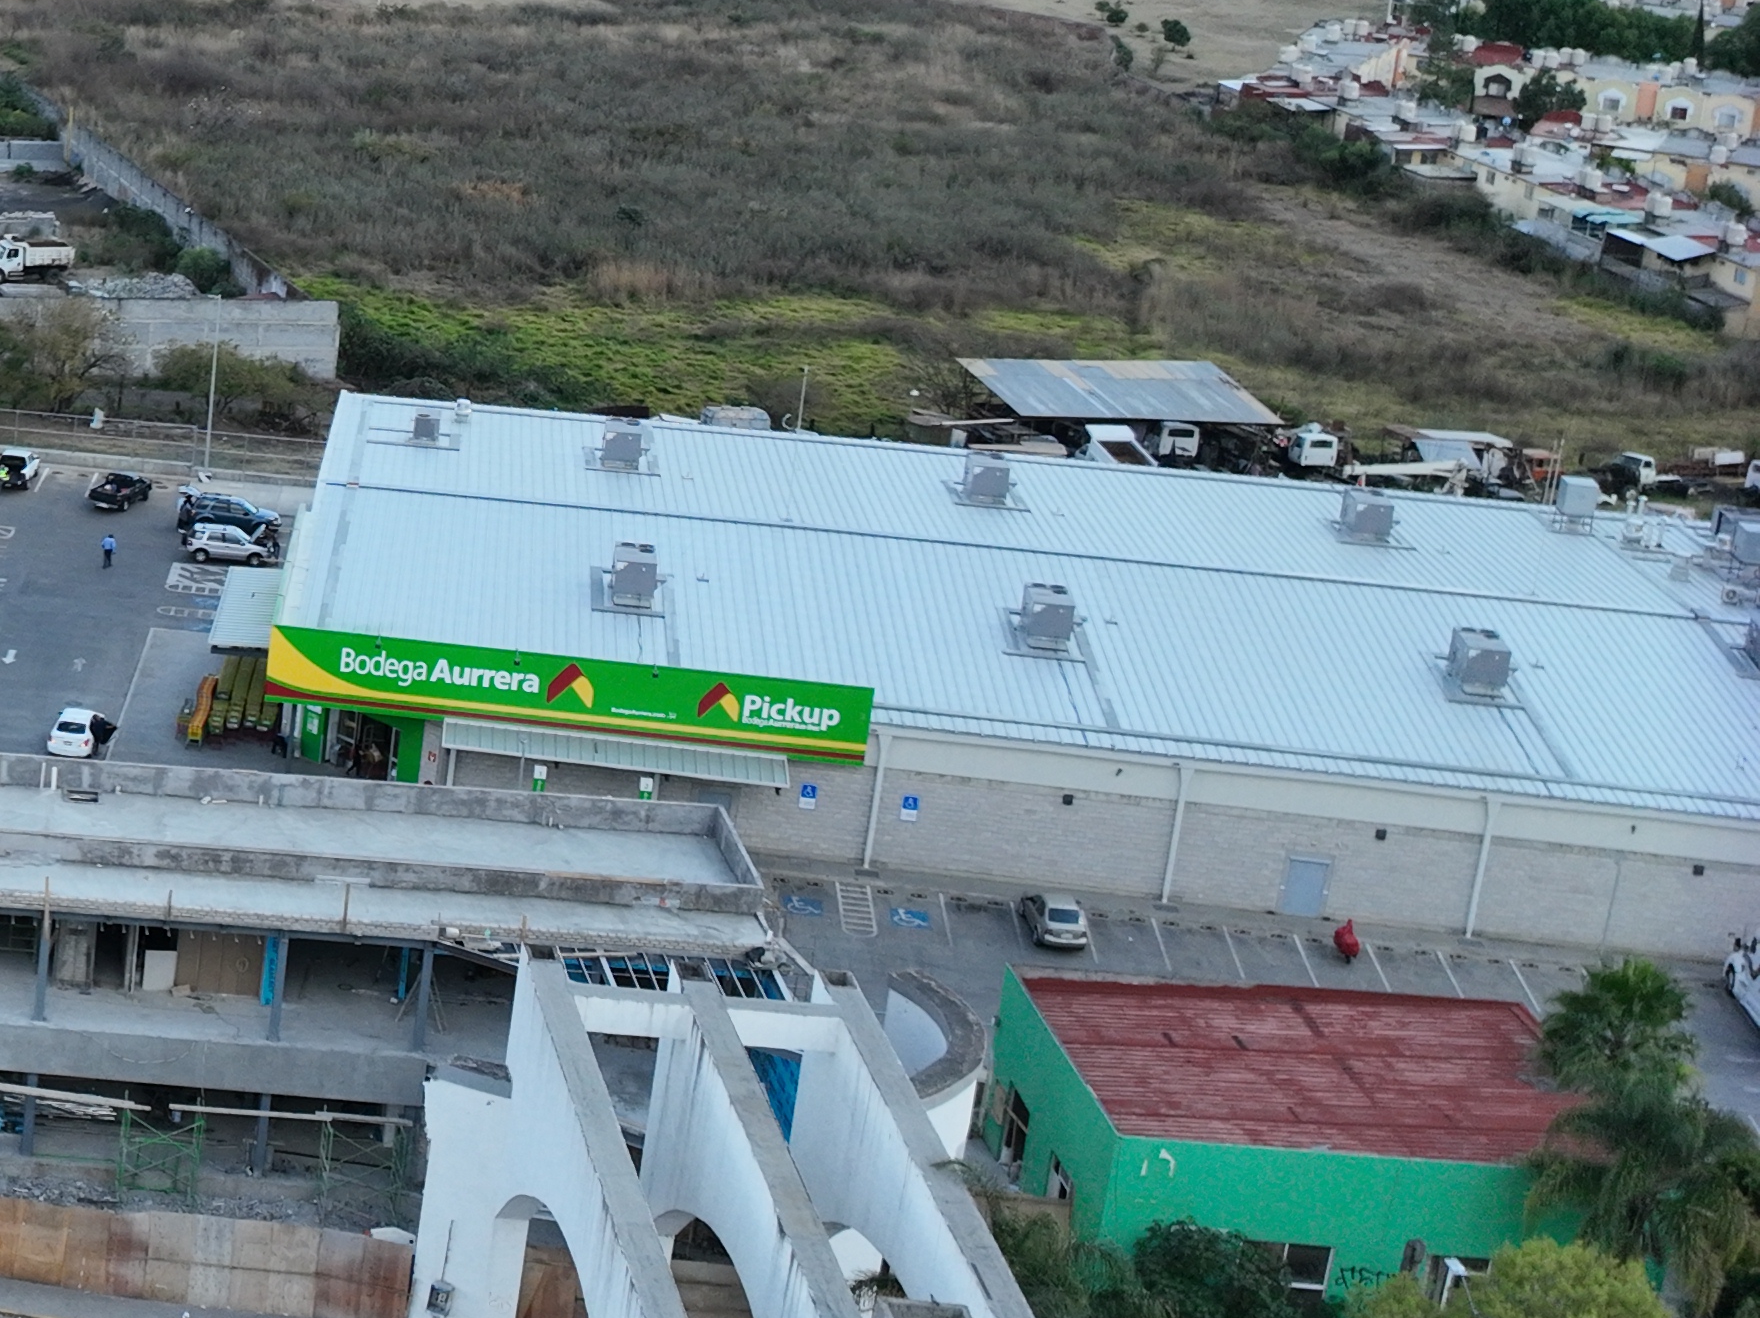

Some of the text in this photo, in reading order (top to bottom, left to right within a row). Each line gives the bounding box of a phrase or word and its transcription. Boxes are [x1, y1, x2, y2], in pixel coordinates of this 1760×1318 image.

[339, 646, 540, 694] Bodega Aurrera
[742, 693, 841, 731] Pickup
